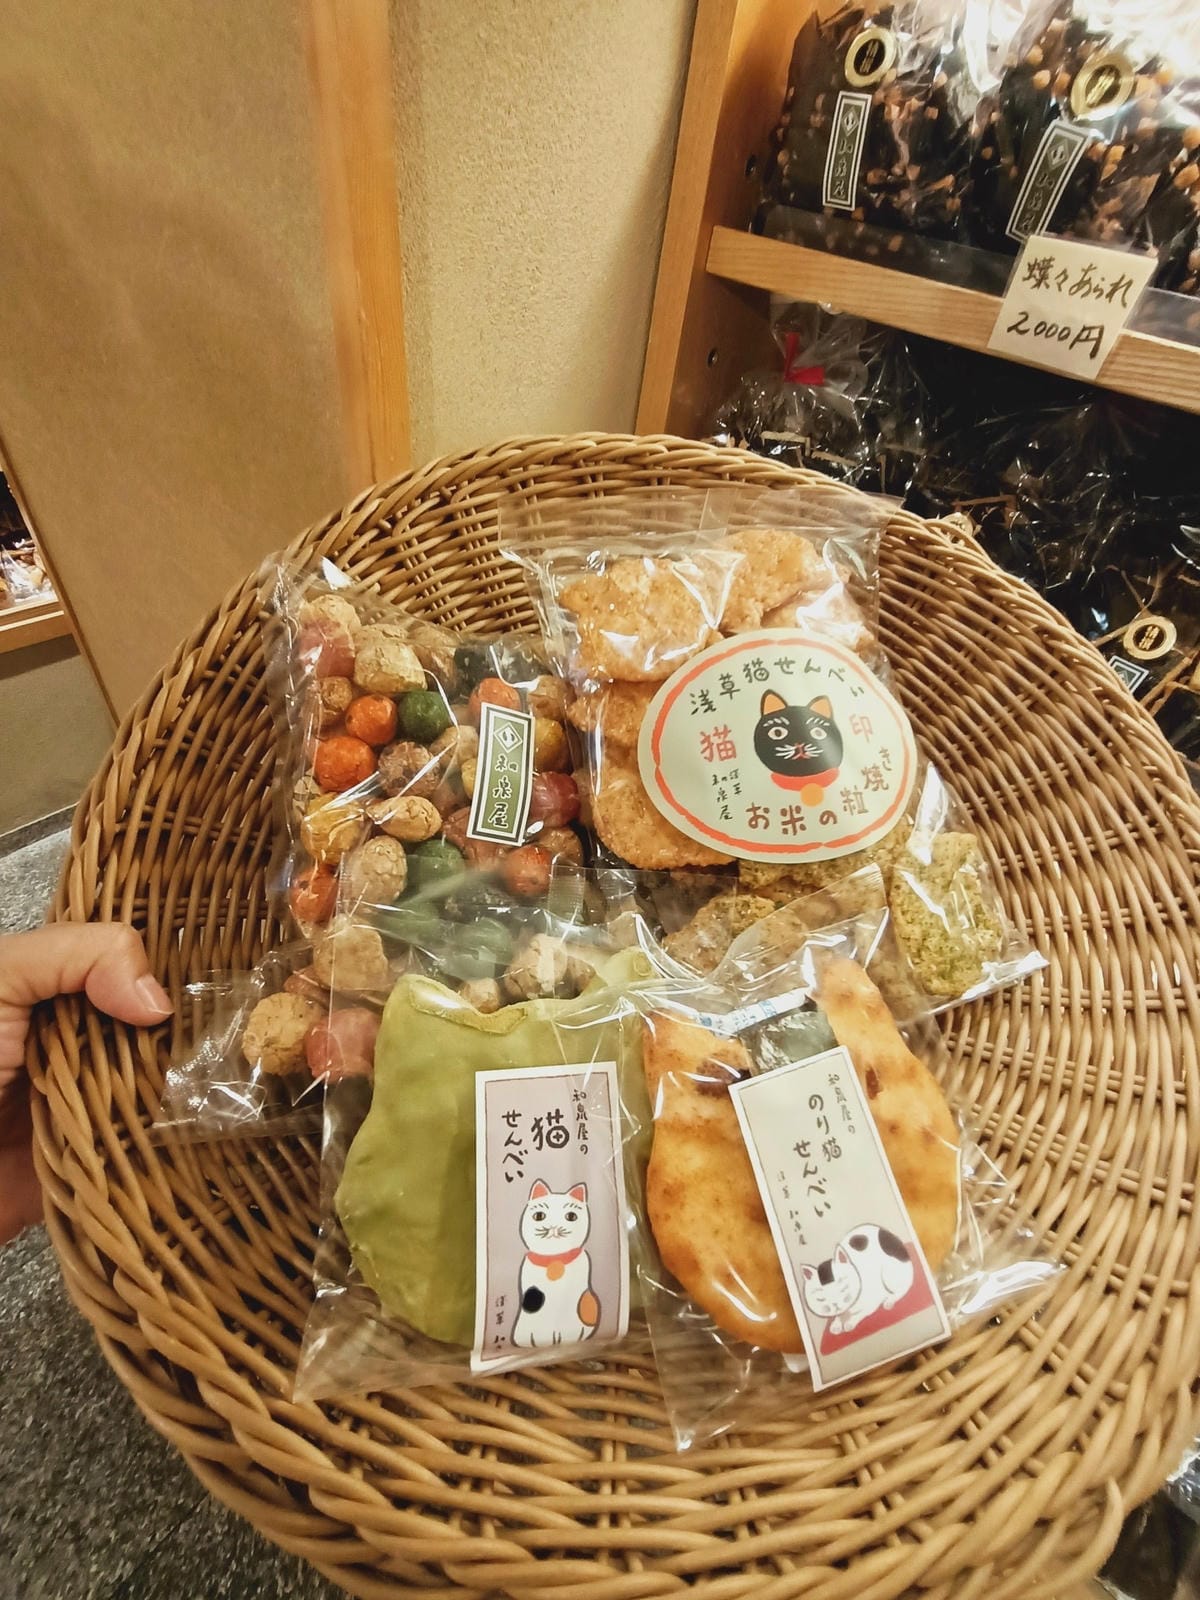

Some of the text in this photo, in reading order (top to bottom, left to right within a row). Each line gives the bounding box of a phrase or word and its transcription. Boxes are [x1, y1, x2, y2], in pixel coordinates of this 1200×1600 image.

[1021, 255, 1134, 309] 蝶々あられ
[1006, 311, 1105, 360] 2000円
[690, 656, 866, 717] 浅草猫せんべい
[699, 714, 874, 763] 猫 印
[501, 1109, 529, 1184] せんべい
[530, 1107, 570, 1151] 猫
[571, 1088, 589, 1156] 和泉屋の
[807, 1093, 843, 1163] のり猫
[793, 1139, 832, 1218] せんべい
